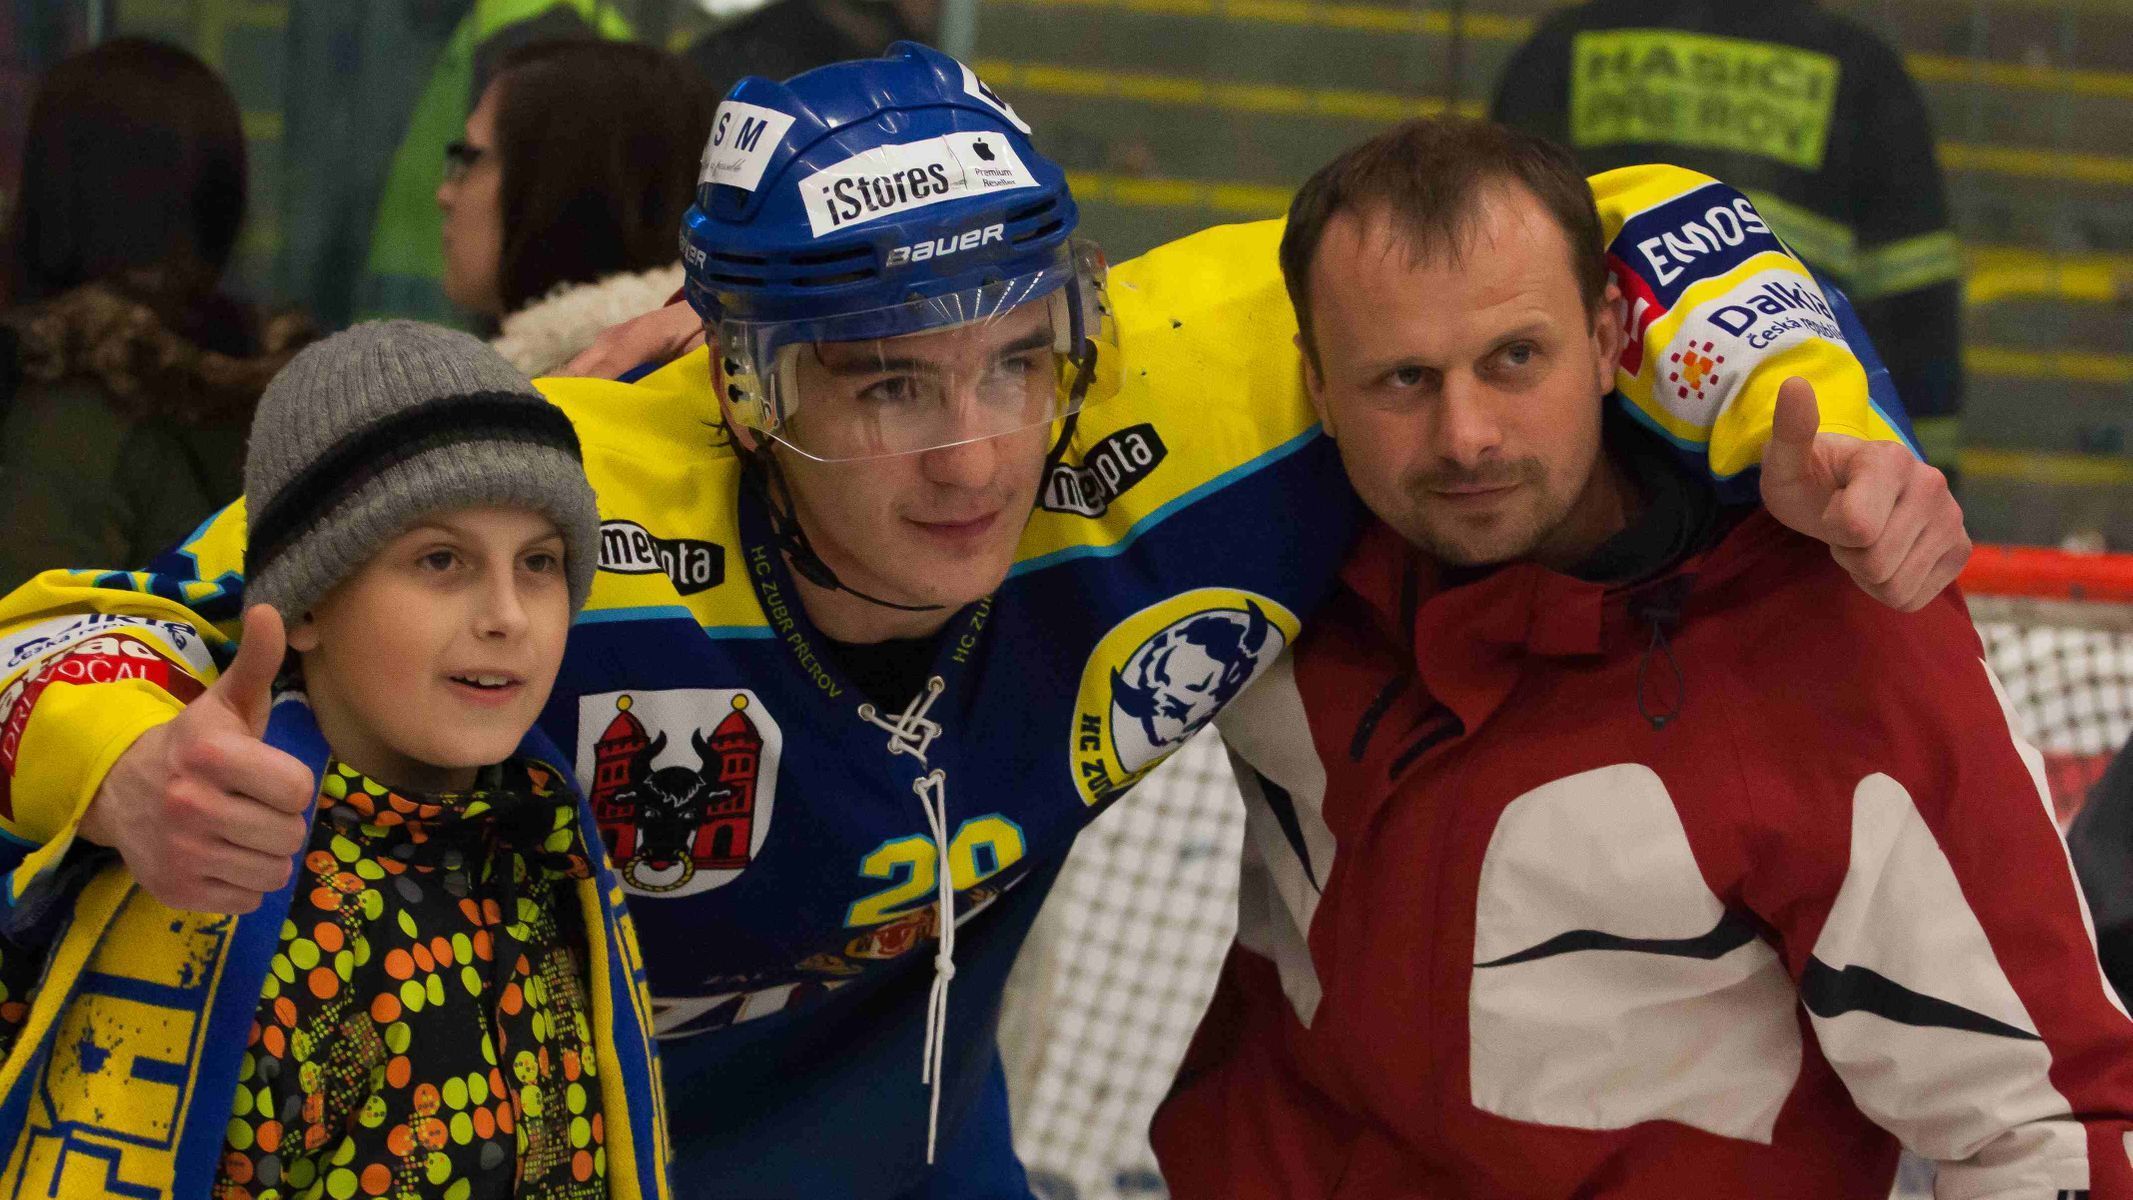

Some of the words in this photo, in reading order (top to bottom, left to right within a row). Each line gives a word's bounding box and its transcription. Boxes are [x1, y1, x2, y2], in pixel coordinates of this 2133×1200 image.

[975, 167, 1013, 177] Premium
[982, 178, 1016, 188] Reseller
[823, 163, 949, 226] iStores
[1637, 198, 1770, 287] EMOS
[1707, 281, 1835, 338] Dalkia
[751, 545, 772, 576] HC
[761, 582, 794, 633] ZUBR
[952, 633, 976, 663] HC
[1080, 713, 1101, 751] HC
